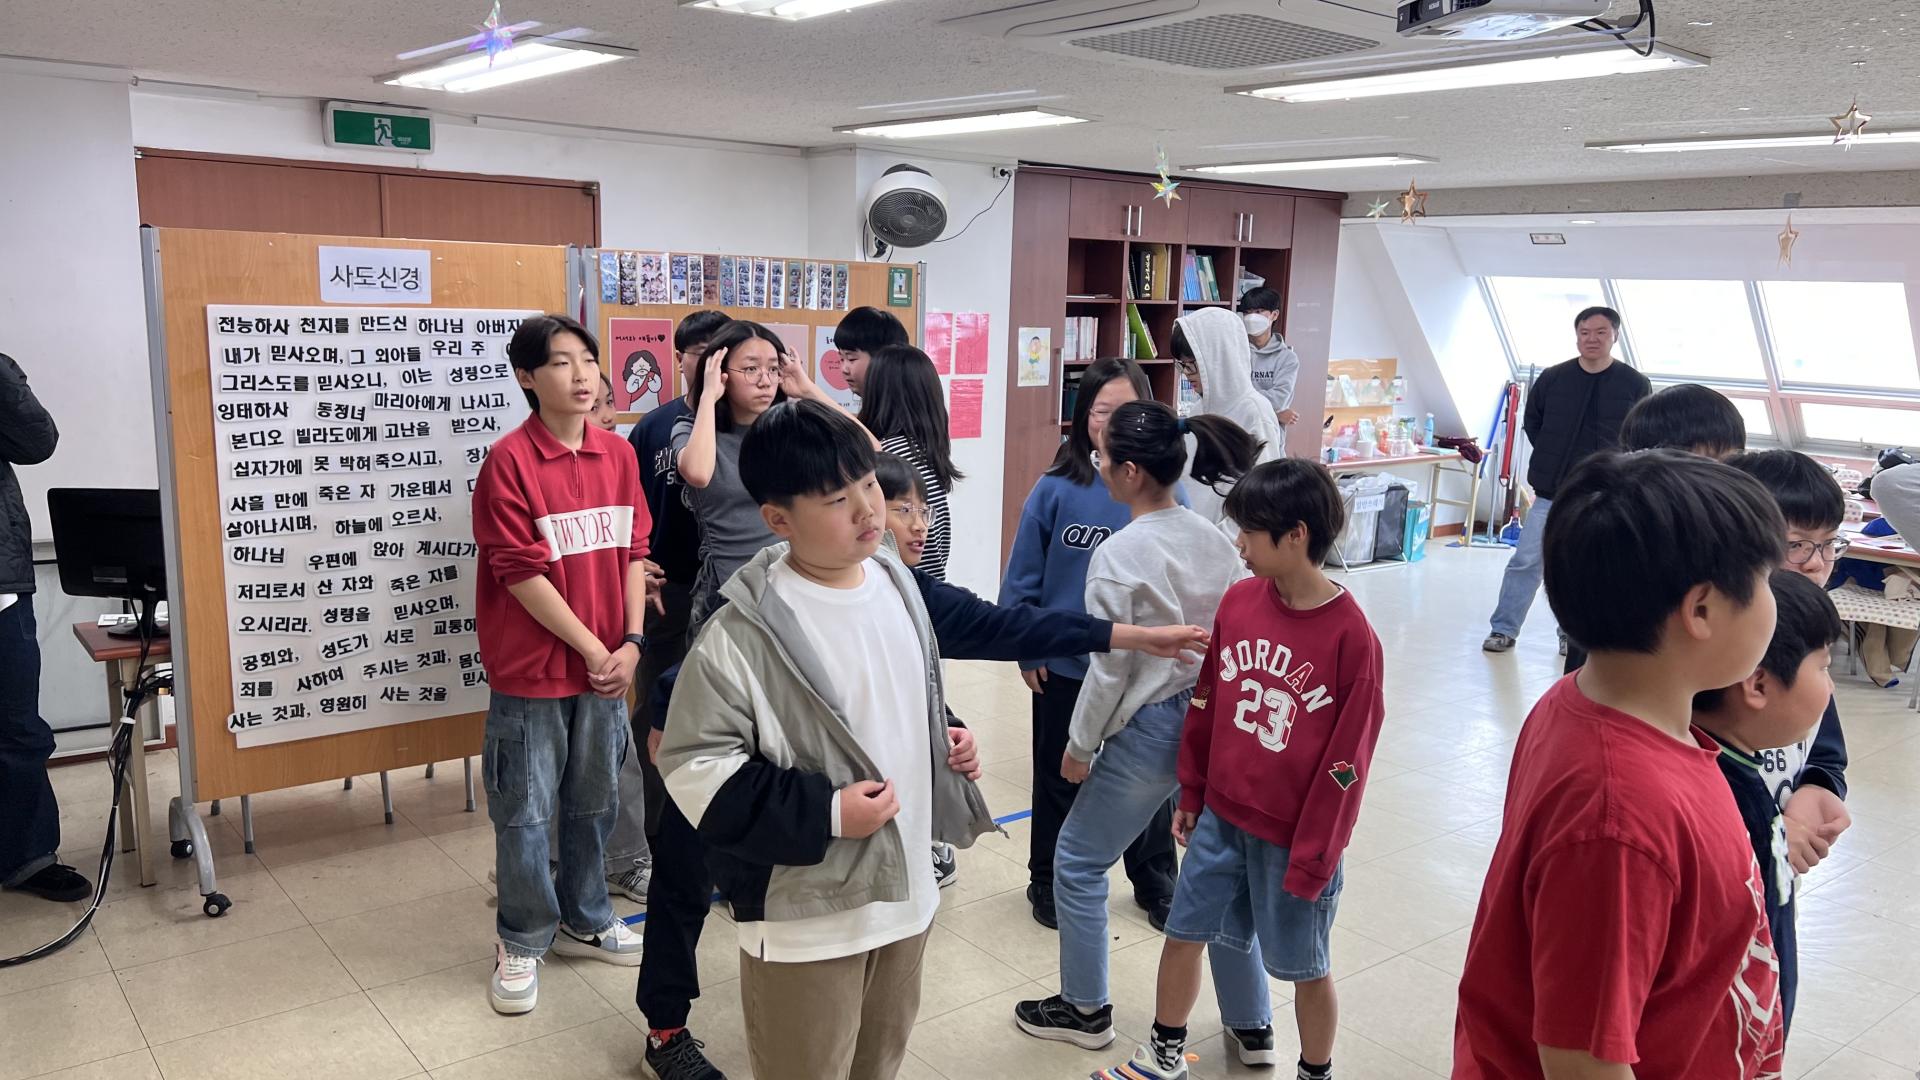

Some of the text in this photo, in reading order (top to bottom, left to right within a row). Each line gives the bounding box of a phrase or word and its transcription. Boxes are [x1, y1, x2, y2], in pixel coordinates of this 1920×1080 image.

[330, 265, 419, 290] 사도신경
[219, 316, 527, 335] 전능하사 천지를 만드신 하나님 아버지
[225, 341, 484, 364] 내가 믿사오며, 그 외아들 우리 주
[223, 364, 508, 391] 그리스도를 믿사오니, 이는 성령으로
[218, 393, 509, 421] 잉태하사 동정녀 마리아에게 나시고,
[232, 417, 500, 449] 본디오 빌라도에게 고난을 받으사,
[234, 460, 302, 476] 십자가에
[315, 457, 329, 471] 못
[340, 456, 370, 471] 박혀
[376, 451, 441, 468] 죽으시고,
[231, 496, 264, 512] 사흘
[275, 492, 307, 508] 만에
[319, 486, 350, 500] 죽은
[361, 484, 375, 498] 자
[391, 480, 451, 497] 가운데서
[227, 507, 441, 537] 살아나시며, 하늘에 오르사,
[552, 511, 616, 550] WYOR
[234, 539, 477, 570] 하나님 우편에 앉아 계시다가
[239, 565, 458, 599] 저리로서 산 자와 죽은 자를
[239, 596, 461, 632] 오시리라. 성령을 믿사오며,
[243, 648, 298, 671] 공회와,
[322, 635, 368, 658] 성도가
[384, 629, 414, 644] 서로
[241, 682, 272, 697] 죄를
[297, 667, 343, 691] 사하여
[364, 659, 408, 678] 주시는
[417, 650, 451, 668] 것과,
[1220, 638, 1334, 713] JORDAN
[229, 711, 262, 728] 사는
[273, 703, 310, 721] 것과,
[320, 695, 366, 713] 영원히
[380, 687, 409, 701] 사는
[419, 687, 447, 701] 것을
[1233, 678, 1298, 753] 23
[1764, 749, 1787, 773] 66
